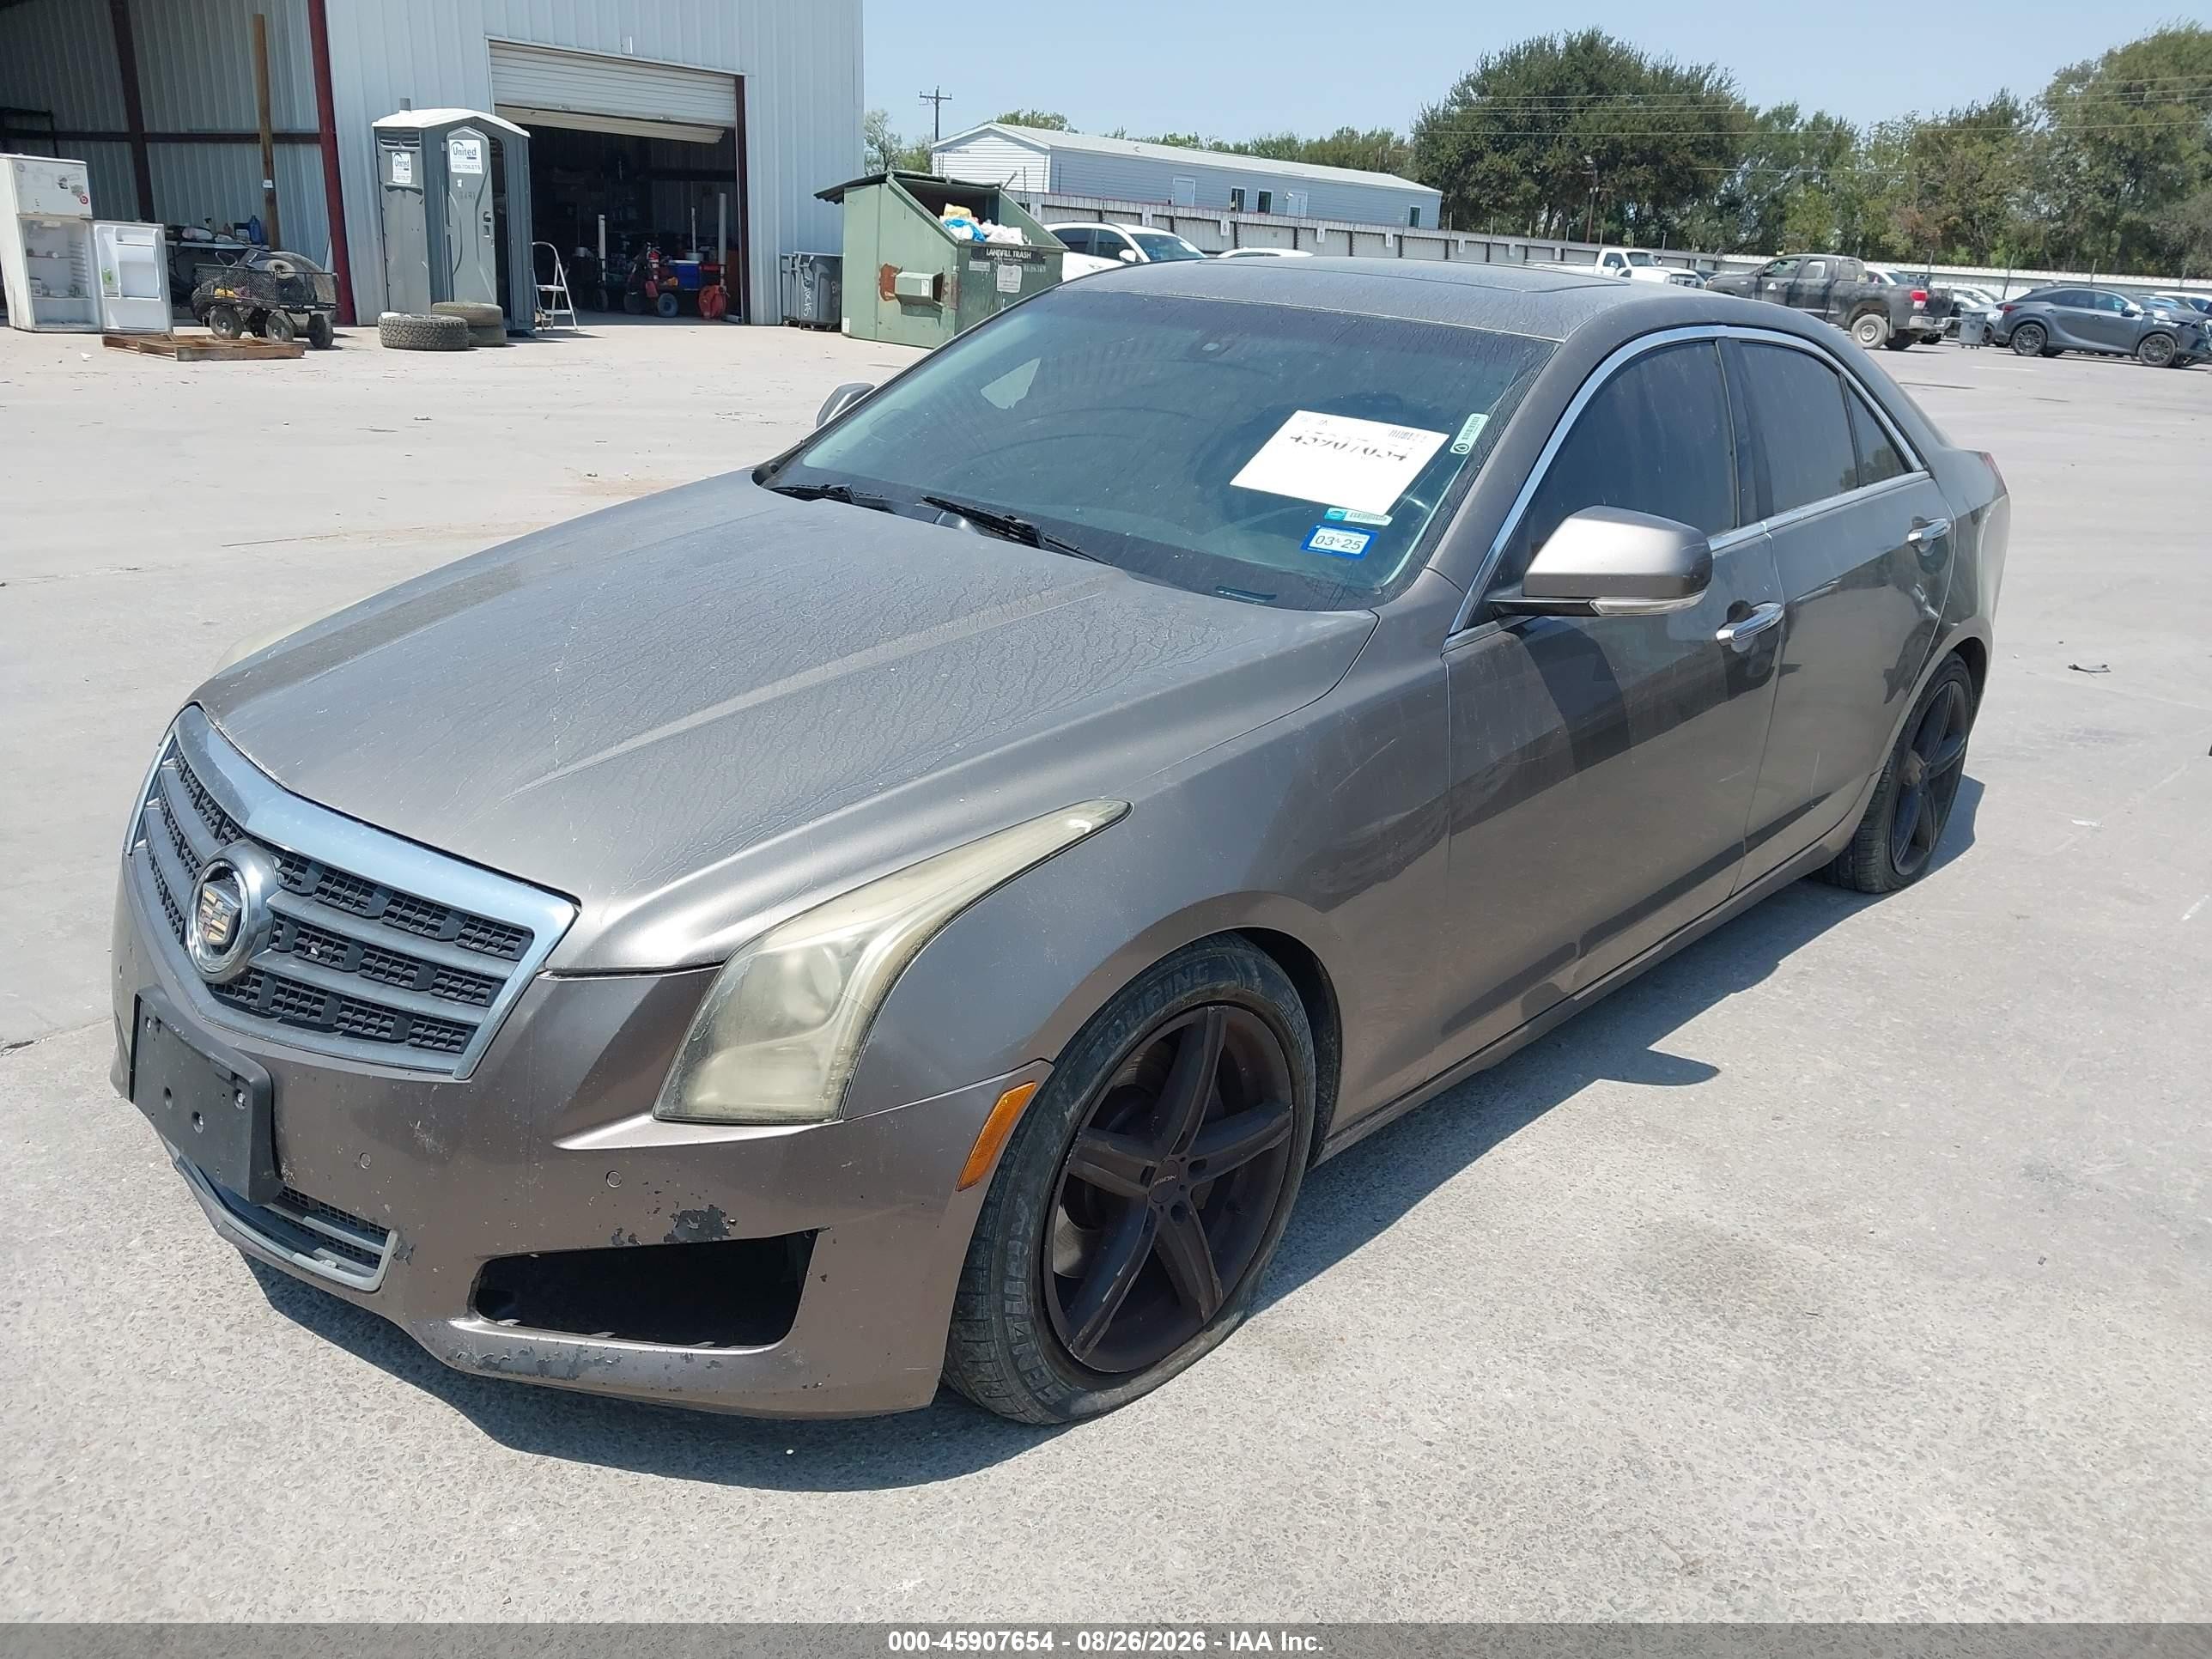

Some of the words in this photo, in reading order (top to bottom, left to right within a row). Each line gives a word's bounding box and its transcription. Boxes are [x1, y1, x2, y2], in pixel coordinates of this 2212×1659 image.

[453, 146, 477, 155] United
[1012, 250, 1031, 259] TRASH
[1315, 535, 1335, 546] 03
[1340, 538, 1364, 550] 25
